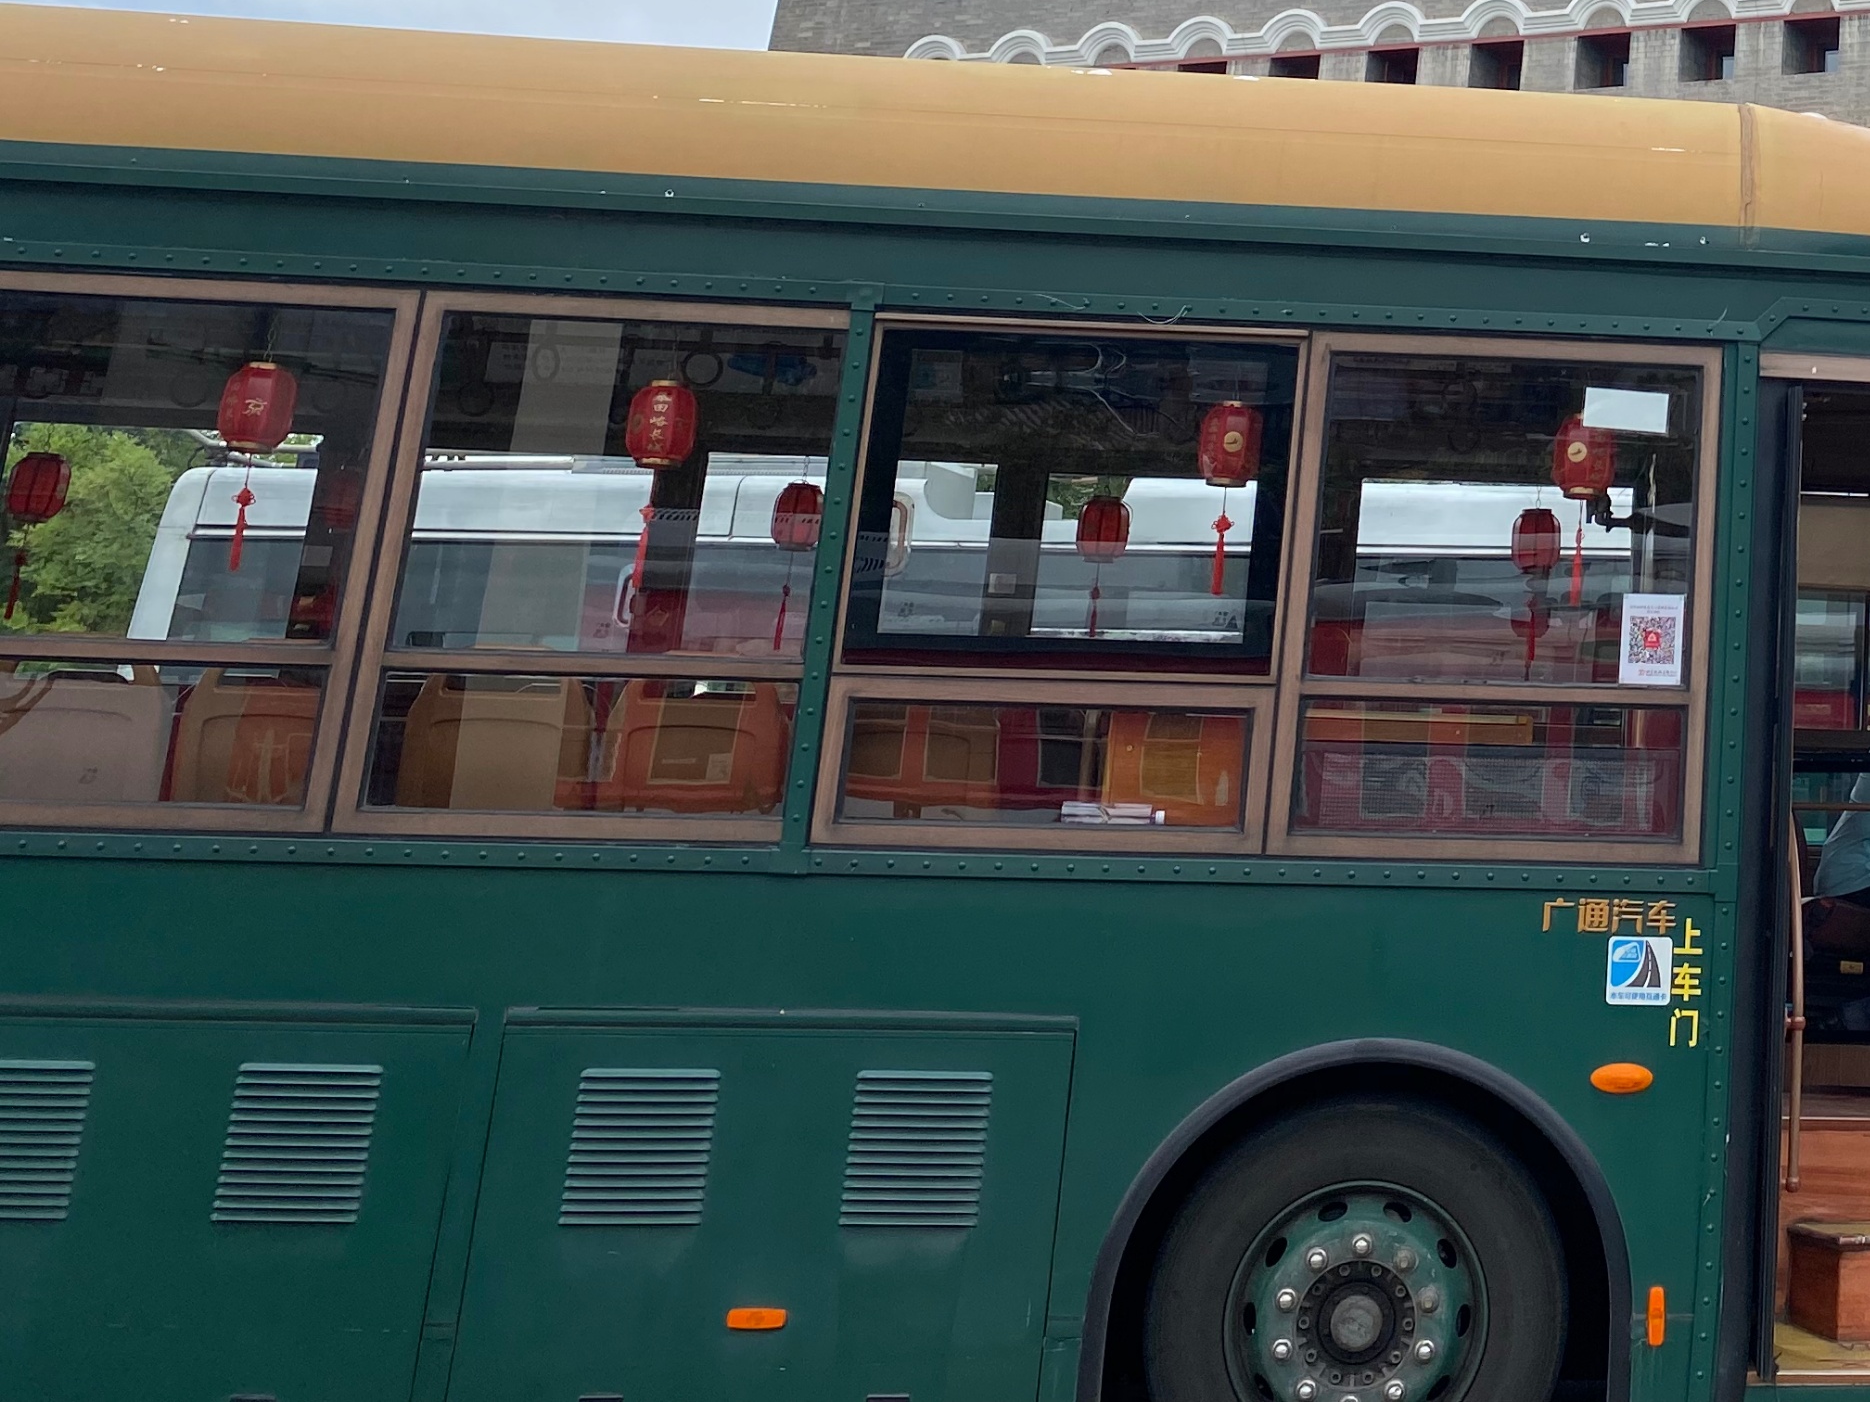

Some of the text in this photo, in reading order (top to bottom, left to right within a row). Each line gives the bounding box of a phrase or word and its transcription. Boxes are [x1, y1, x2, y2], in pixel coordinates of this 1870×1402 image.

[1541, 897, 1677, 935] 广通汽车
[1669, 917, 1703, 1047] 上车门
